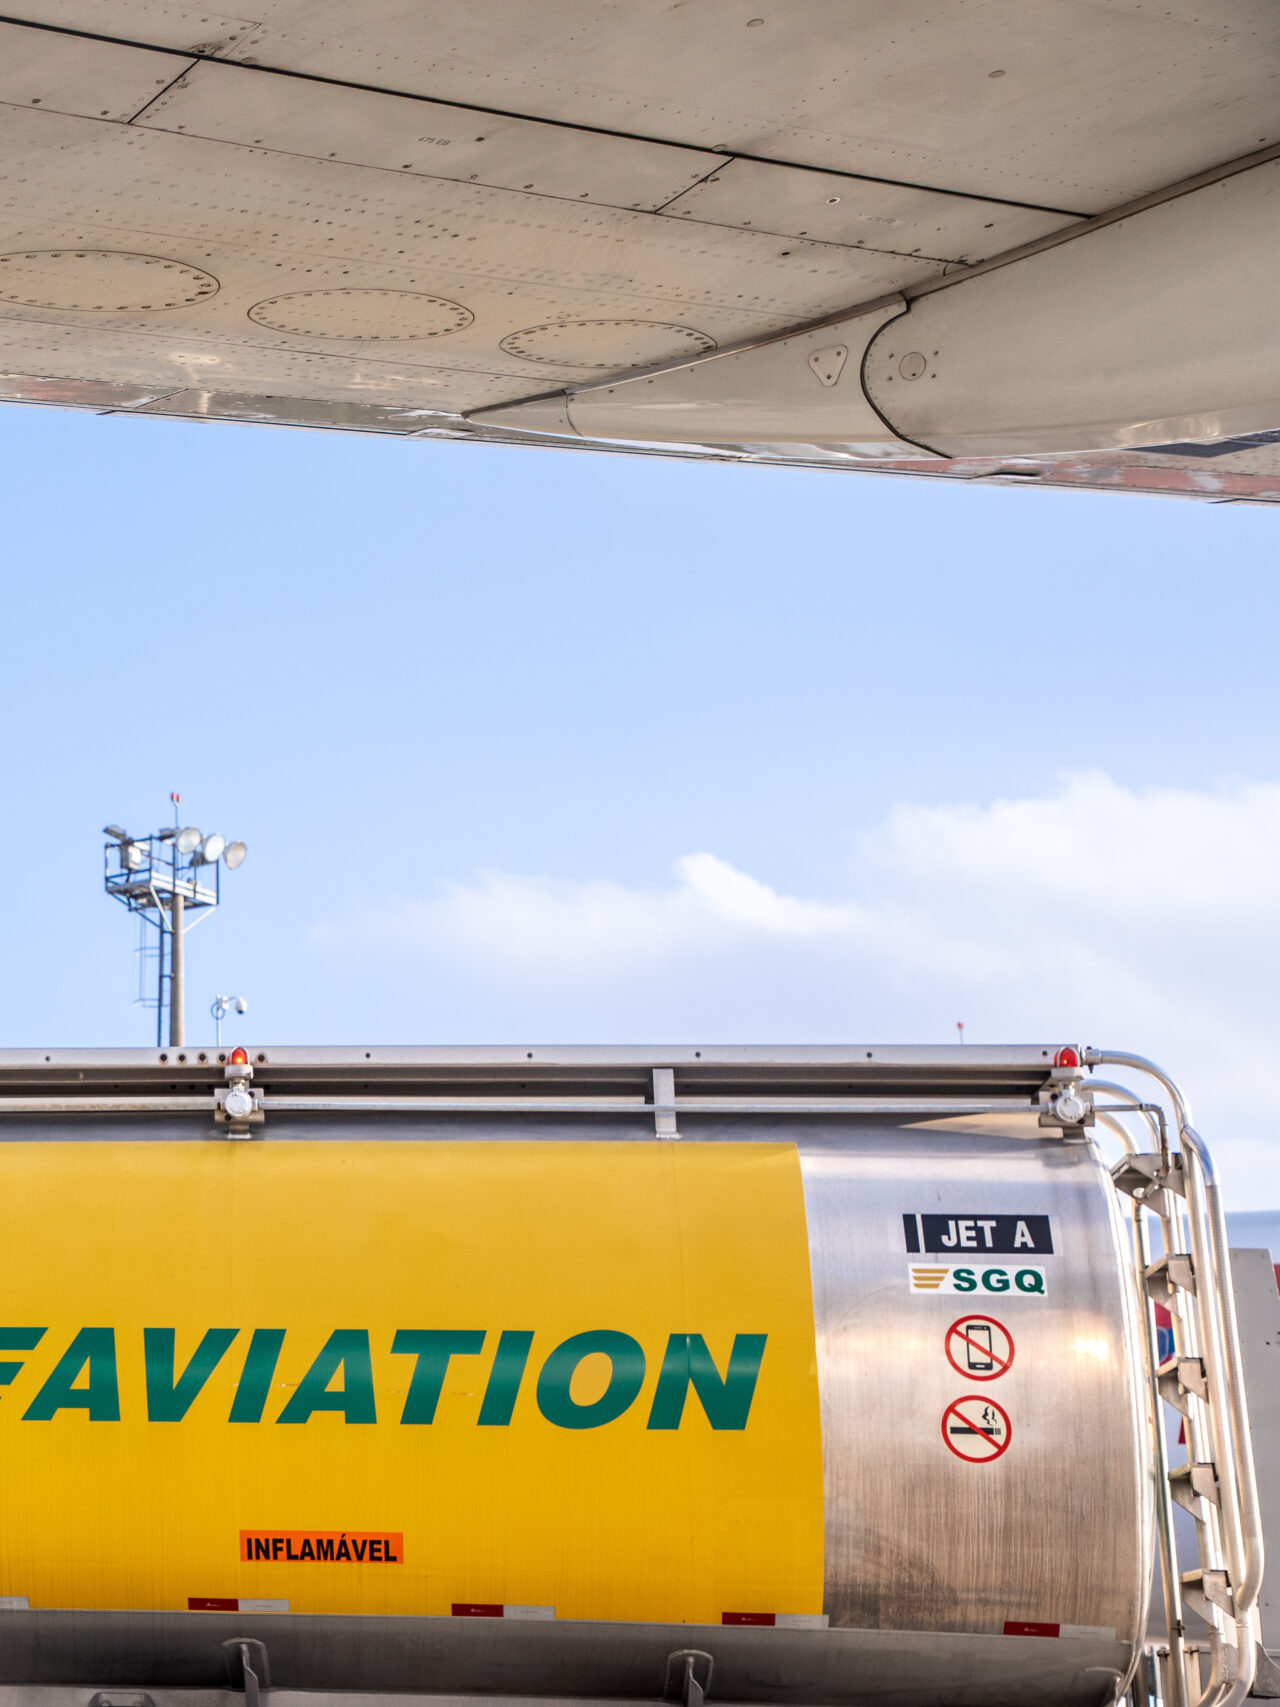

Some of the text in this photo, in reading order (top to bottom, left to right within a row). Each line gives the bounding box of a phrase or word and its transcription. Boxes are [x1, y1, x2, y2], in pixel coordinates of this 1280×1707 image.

[941, 1220, 1035, 1248] JET A
[953, 1268, 1046, 1295] SGQ
[21, 1327, 768, 1431] AVIATION
[246, 1533, 398, 1562] INFLAMÁVEL
